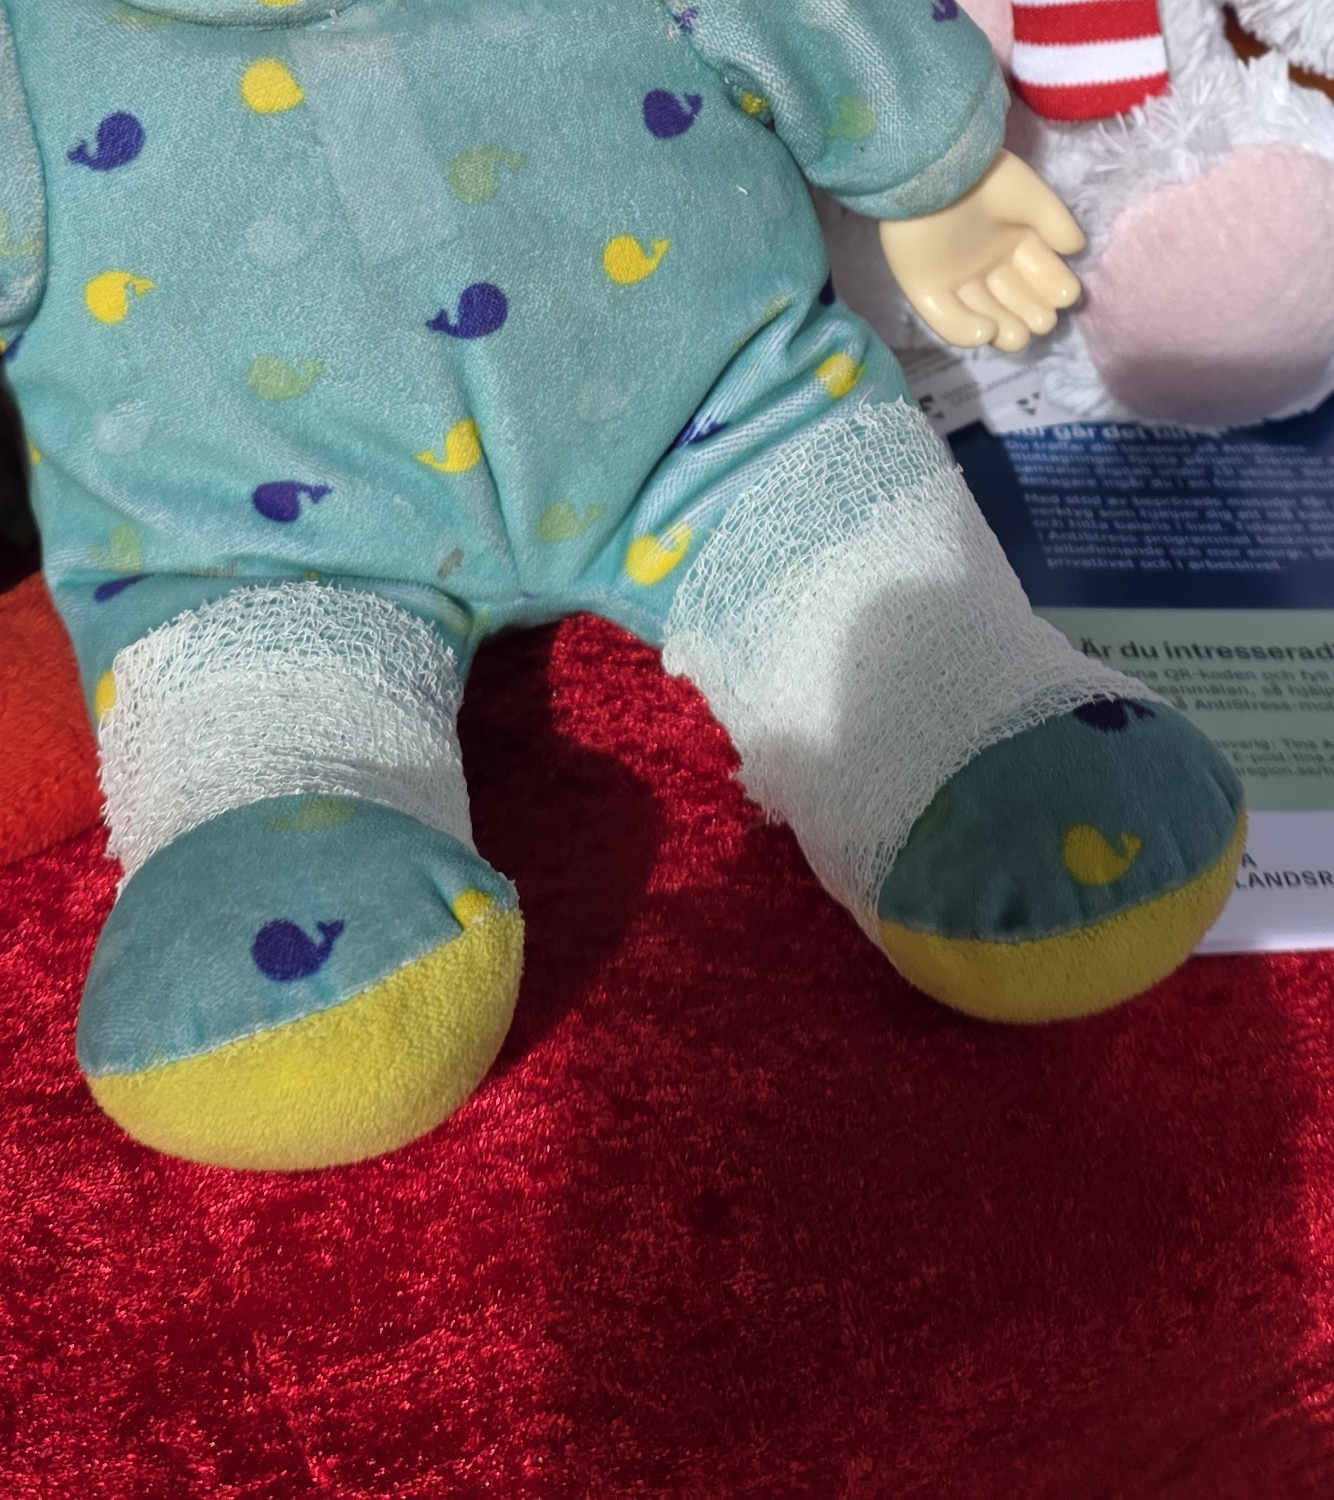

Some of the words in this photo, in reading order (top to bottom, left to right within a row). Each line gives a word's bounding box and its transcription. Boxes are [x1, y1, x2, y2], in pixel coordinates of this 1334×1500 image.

[1079, 636, 1113, 660] Är
[1119, 639, 1160, 661] du
[1163, 667, 1258, 682] QR-koden
[1261, 669, 1297, 682] och
